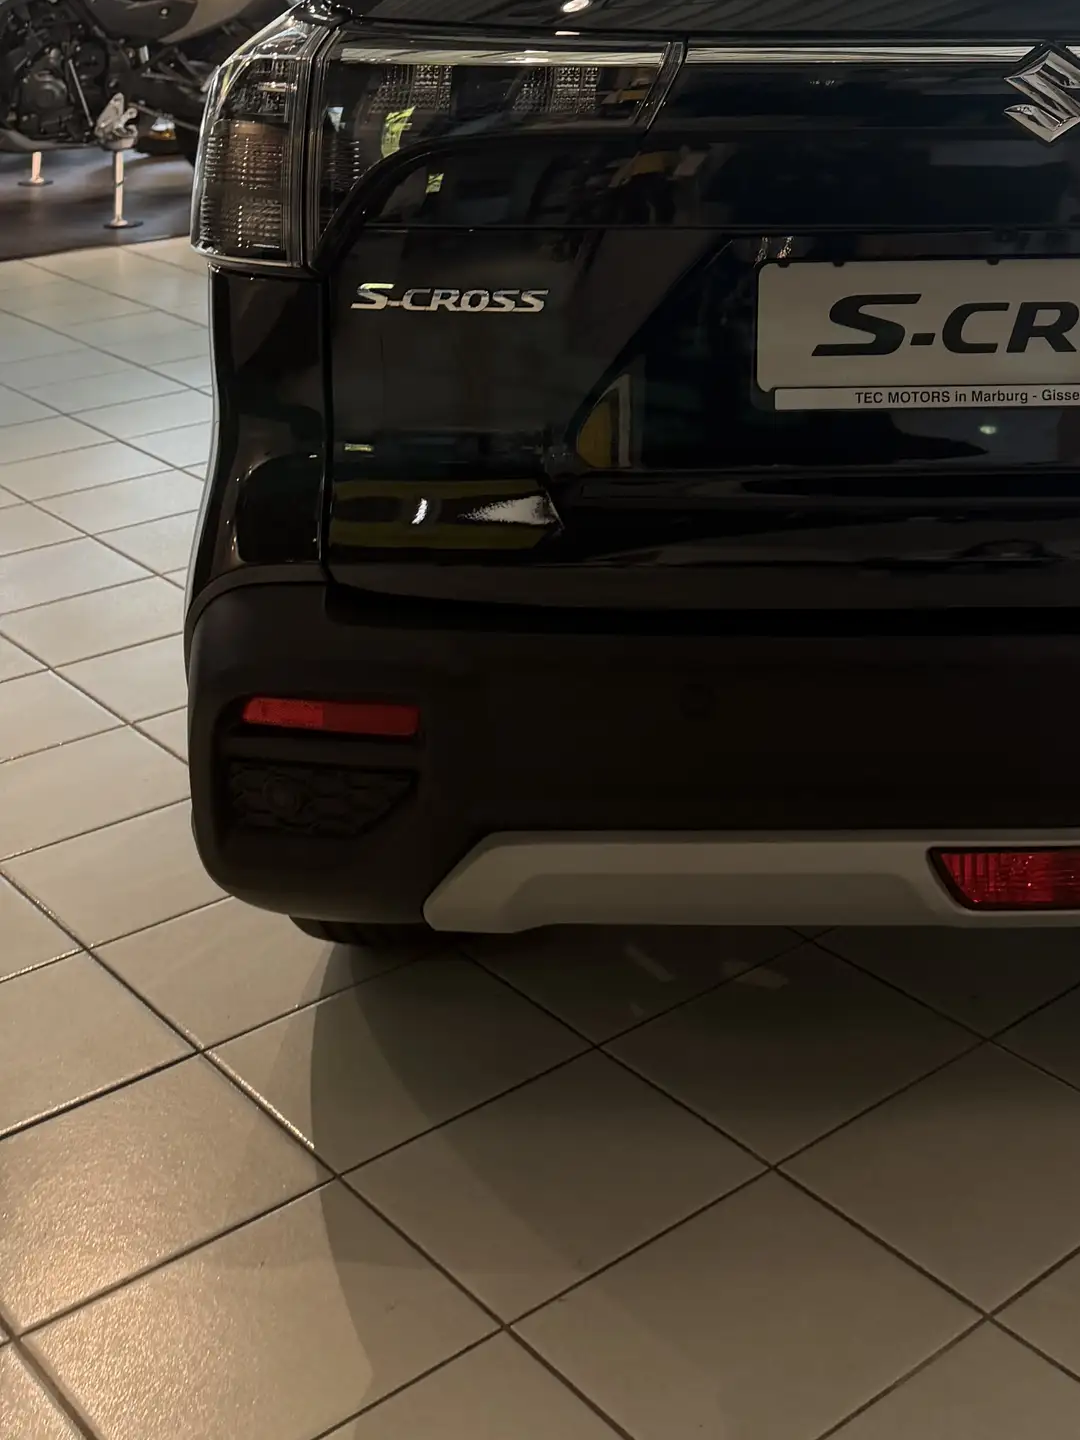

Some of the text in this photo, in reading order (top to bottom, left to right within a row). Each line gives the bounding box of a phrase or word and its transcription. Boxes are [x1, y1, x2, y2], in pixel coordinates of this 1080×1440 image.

[350, 282, 549, 313] S-CROSS
[855, 391, 883, 404] TEC
[888, 390, 950, 403] MOTORS
[954, 390, 967, 402] in
[971, 389, 1028, 404] Marburg
